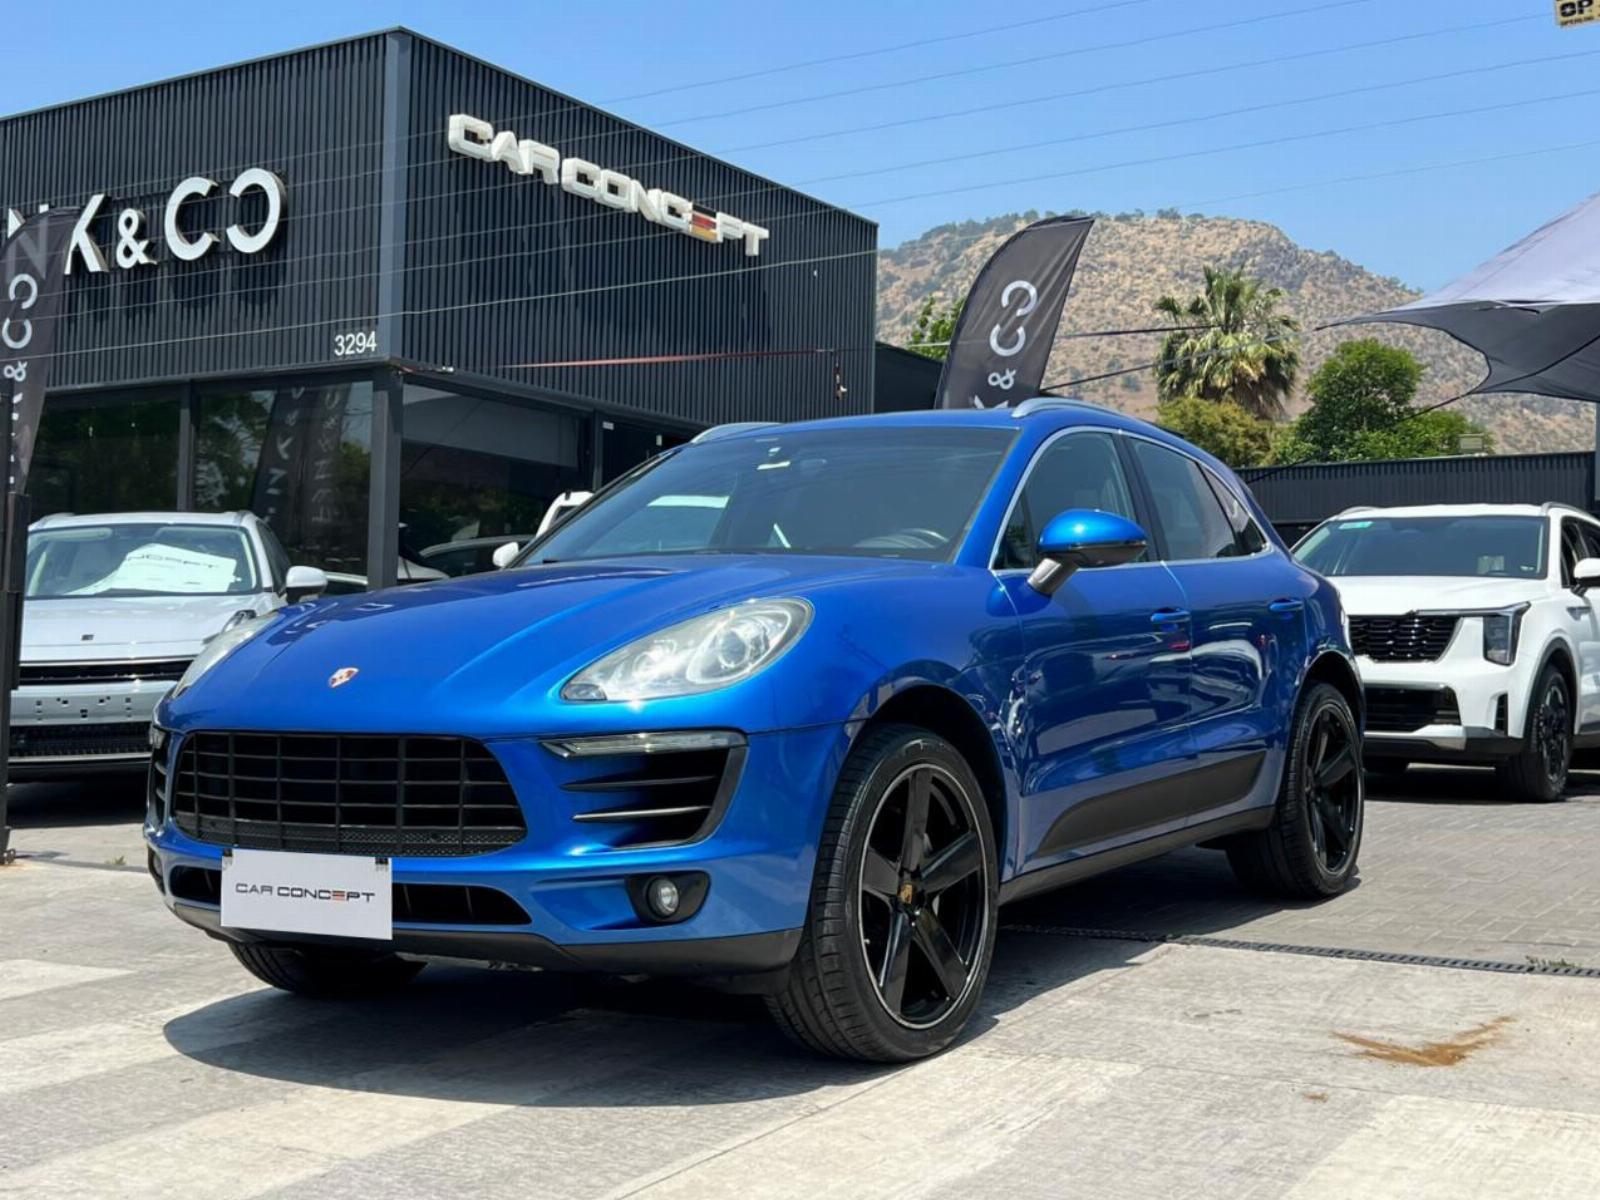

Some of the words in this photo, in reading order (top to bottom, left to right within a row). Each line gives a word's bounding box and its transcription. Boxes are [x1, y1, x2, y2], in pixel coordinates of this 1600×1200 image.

[448, 113, 561, 185] CAR
[561, 156, 770, 257] CONCEPT
[334, 330, 378, 356] 3294
[236, 883, 273, 896] CAR
[277, 886, 375, 902] CONCEPT
